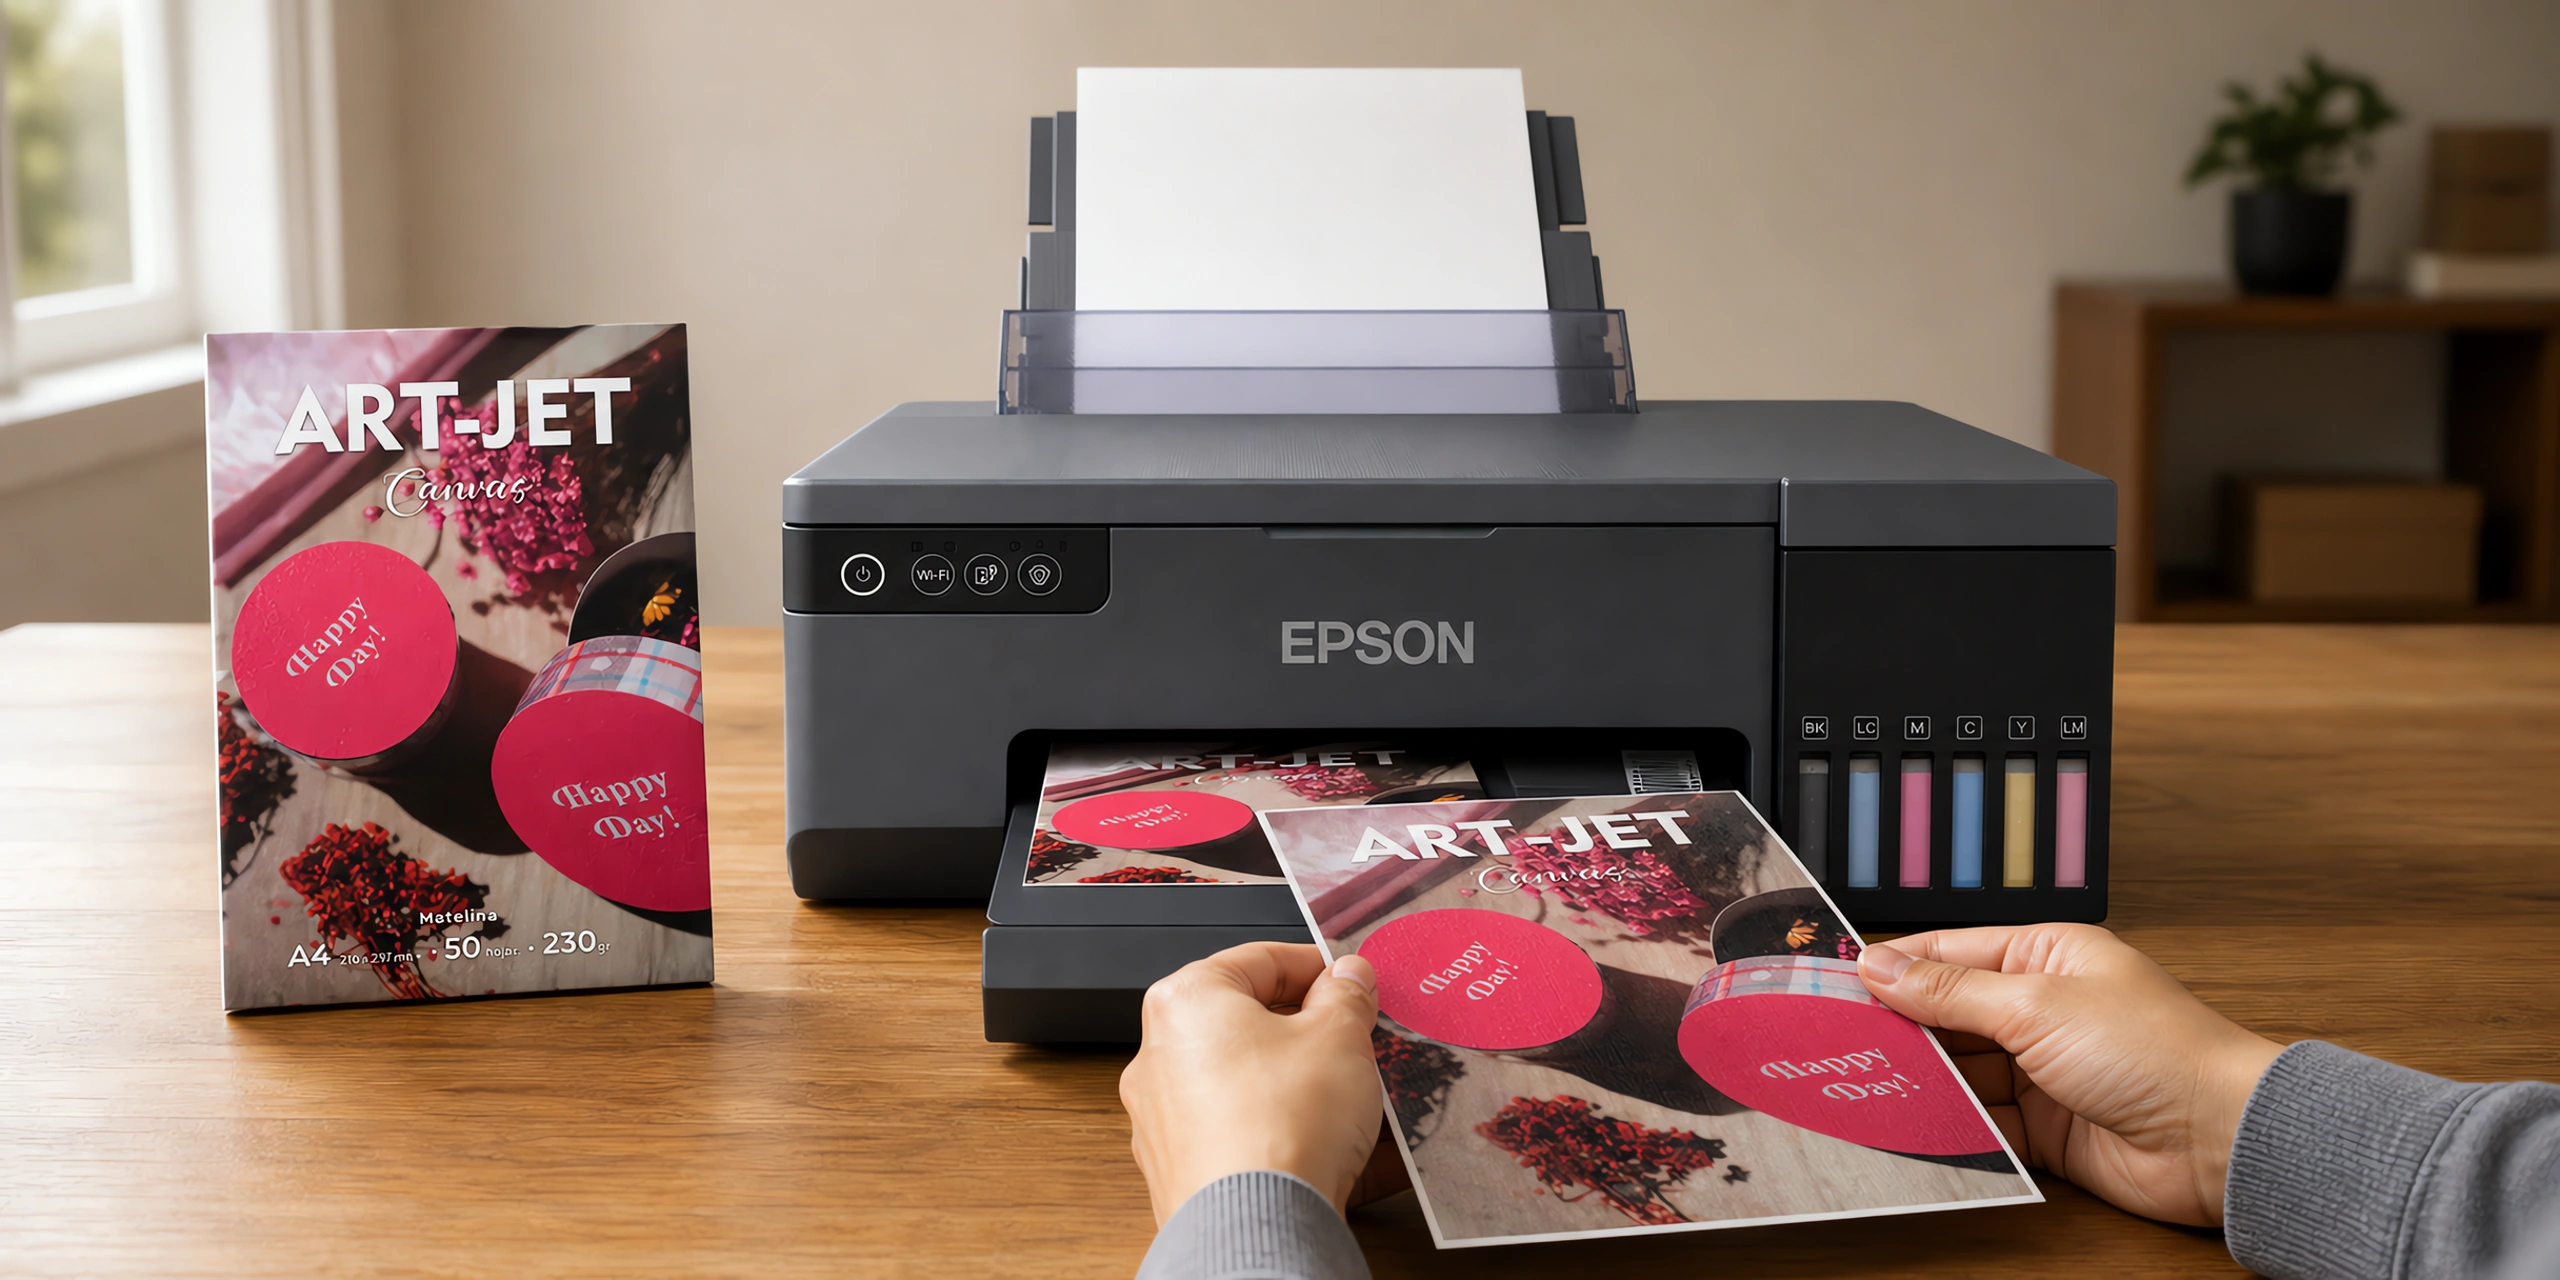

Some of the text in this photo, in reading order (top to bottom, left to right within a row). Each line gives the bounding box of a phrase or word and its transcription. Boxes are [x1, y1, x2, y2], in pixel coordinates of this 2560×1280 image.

[275, 376, 632, 455] ART-JET
[383, 467, 534, 517] Canvas
[286, 596, 368, 677] Happy
[1281, 619, 1475, 665] EPSON
[326, 625, 386, 687] Day!
[1804, 721, 1826, 735] BK
[1856, 721, 1877, 735] LC
[1910, 721, 1925, 734] M
[1963, 721, 1976, 735] C
[2016, 721, 2028, 734] Y
[2063, 721, 2084, 734] LM
[1102, 750, 1406, 771] ART-JET
[552, 771, 667, 810] Happy
[593, 804, 681, 840] Day!
[1350, 809, 1694, 864] ART-JET
[287, 943, 332, 968] A4
[444, 936, 481, 960] 50
[542, 930, 597, 955] 230
[1419, 940, 1492, 995] Happy
[1466, 957, 1519, 1001] Day!
[1760, 1047, 1891, 1080] Happy
[1822, 1072, 1921, 1102] Day!
